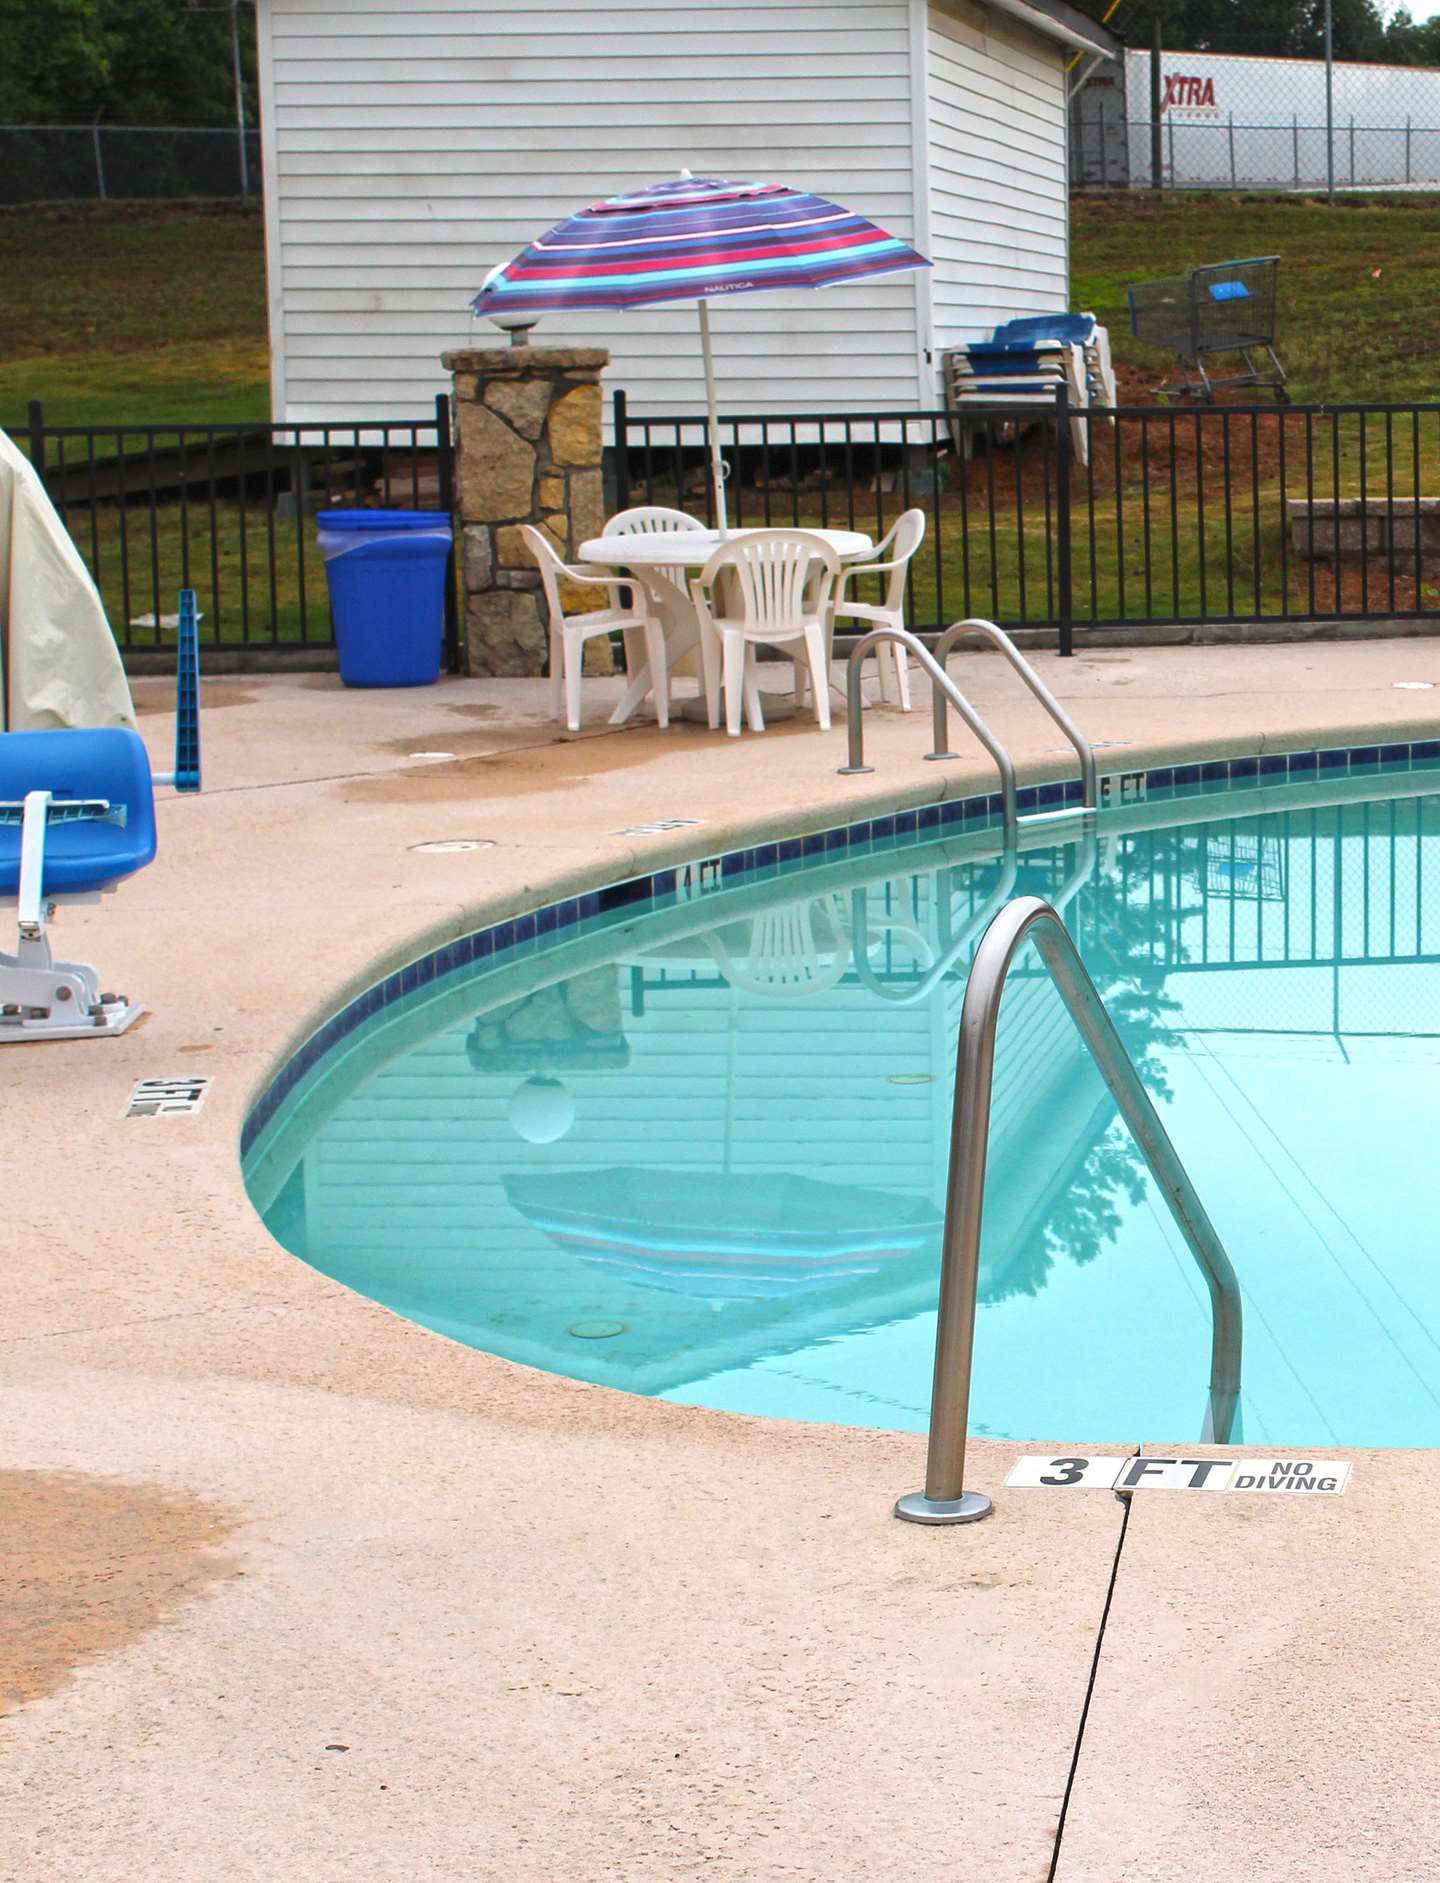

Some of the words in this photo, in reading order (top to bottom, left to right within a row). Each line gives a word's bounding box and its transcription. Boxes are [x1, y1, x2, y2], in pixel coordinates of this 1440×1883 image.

[1161, 72, 1216, 113] XTRA
[704, 281, 754, 292] NAUTICA
[1039, 1458, 1089, 1486] 3
[1123, 1458, 1233, 1489] FT
[1270, 1462, 1313, 1476] NO
[1234, 1476, 1339, 1491] DIVING
